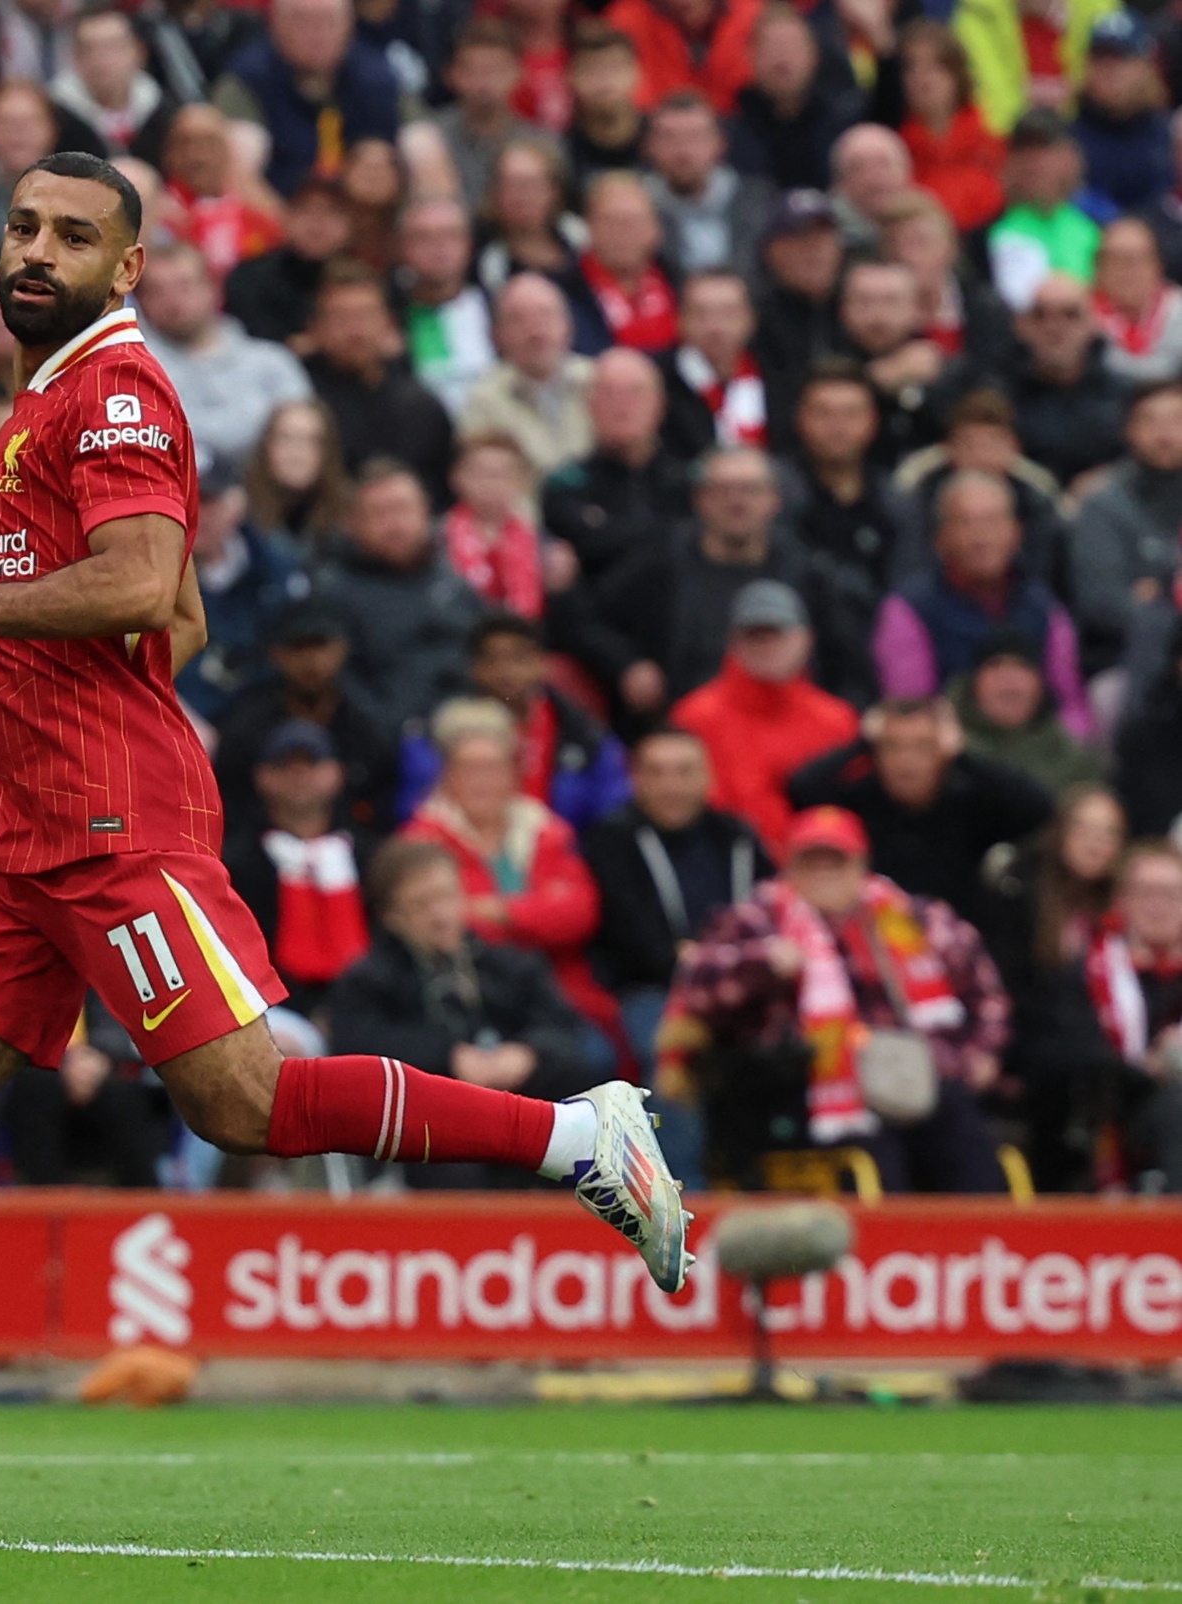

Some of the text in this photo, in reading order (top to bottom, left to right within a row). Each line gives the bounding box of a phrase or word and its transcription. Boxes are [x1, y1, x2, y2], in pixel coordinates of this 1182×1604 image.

[79, 425, 172, 453] Expedia
[106, 911, 185, 1003] 11
[225, 1233, 717, 1332] standard
